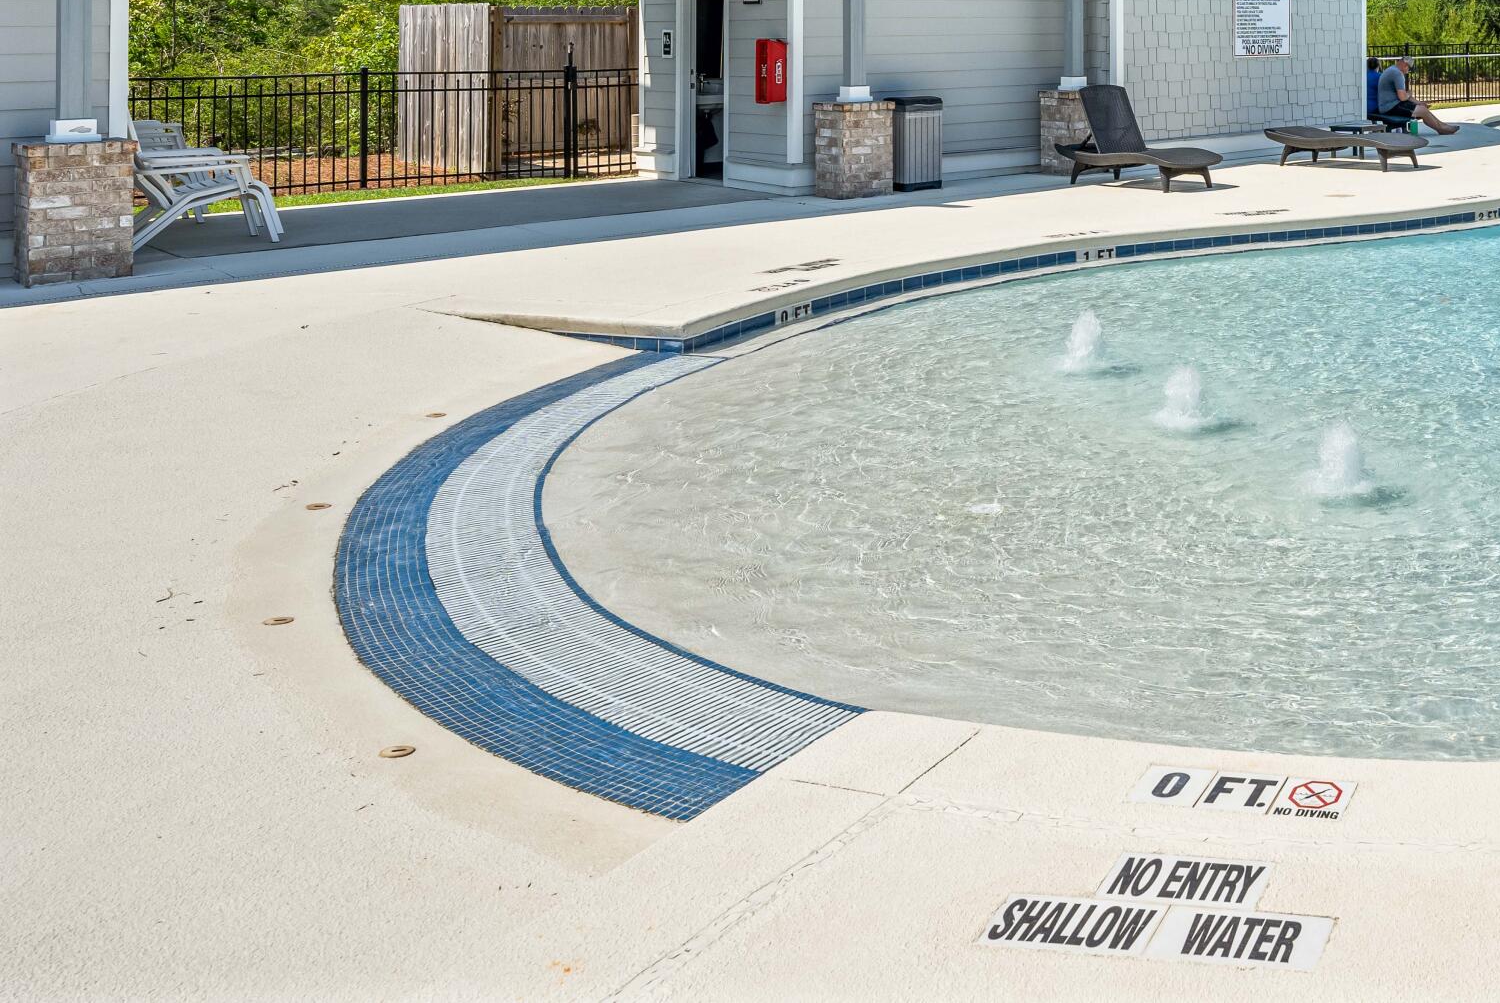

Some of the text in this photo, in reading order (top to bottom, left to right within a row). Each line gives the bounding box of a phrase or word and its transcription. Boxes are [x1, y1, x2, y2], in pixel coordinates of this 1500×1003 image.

[1479, 210, 1497, 221] 2 FT
[1083, 248, 1114, 260] 1 FT
[794, 303, 810, 318] FT
[1203, 776, 1278, 807] FT.
[1273, 807, 1339, 820] NO DIVING
[1107, 857, 1266, 904] NO ENTRY
[988, 898, 1303, 963] SHALLOW WATER
